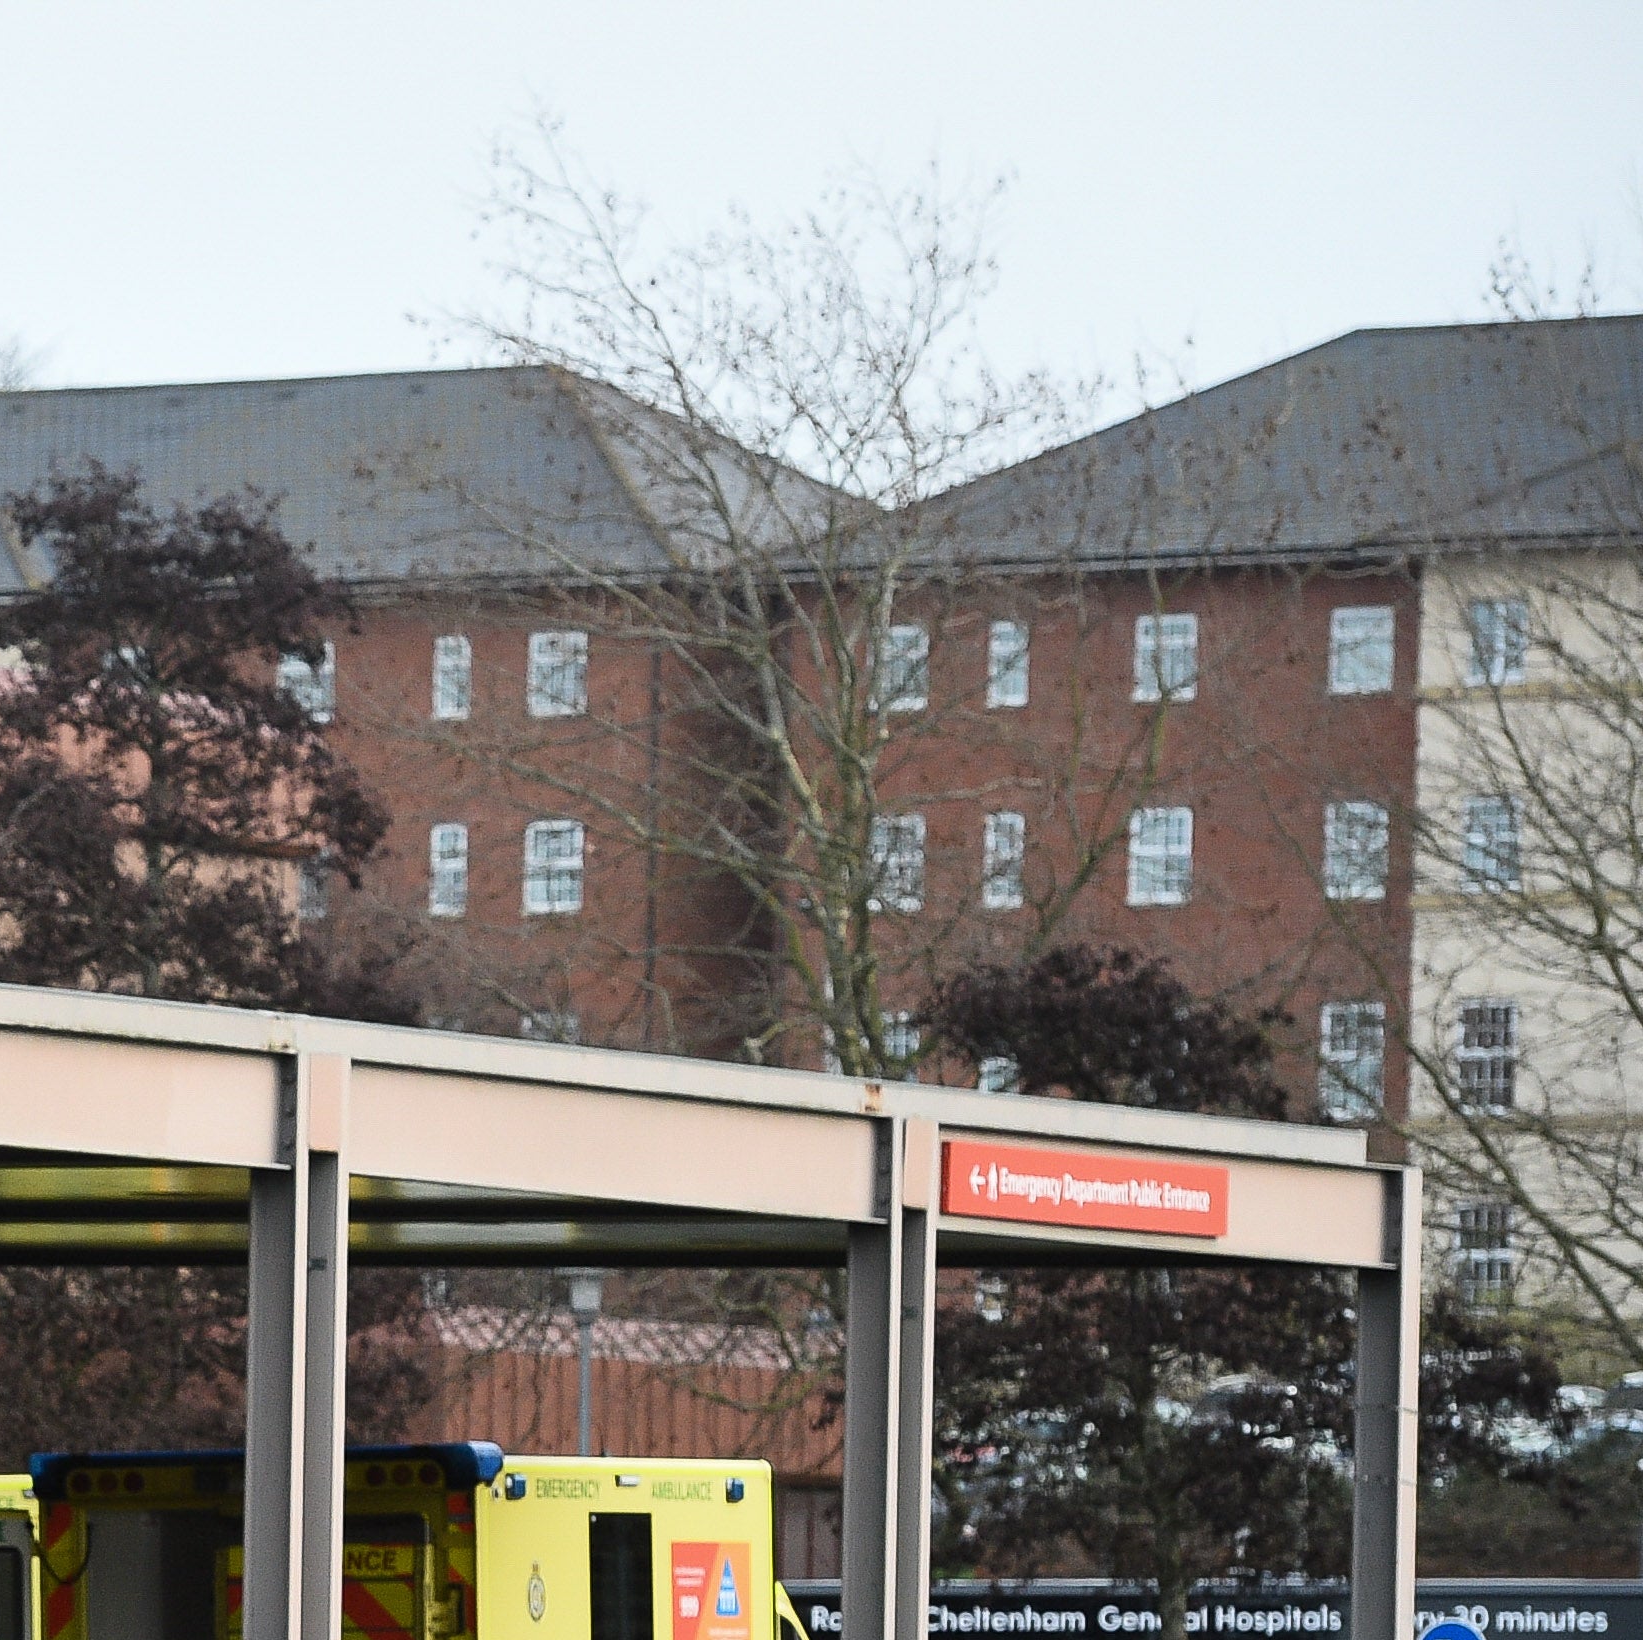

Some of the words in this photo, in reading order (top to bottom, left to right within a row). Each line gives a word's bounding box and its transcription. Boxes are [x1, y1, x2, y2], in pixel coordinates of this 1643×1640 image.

[1000, 1167, 1063, 1206] Emergency
[1065, 1173, 1129, 1208] Department
[1130, 1179, 1163, 1208] Public
[536, 1478, 600, 1498] EMERGENCY
[652, 1480, 713, 1500] AMBULANCE
[1215, 1604, 1342, 1636] Hospitals
[1495, 1604, 1609, 1634] minutes
